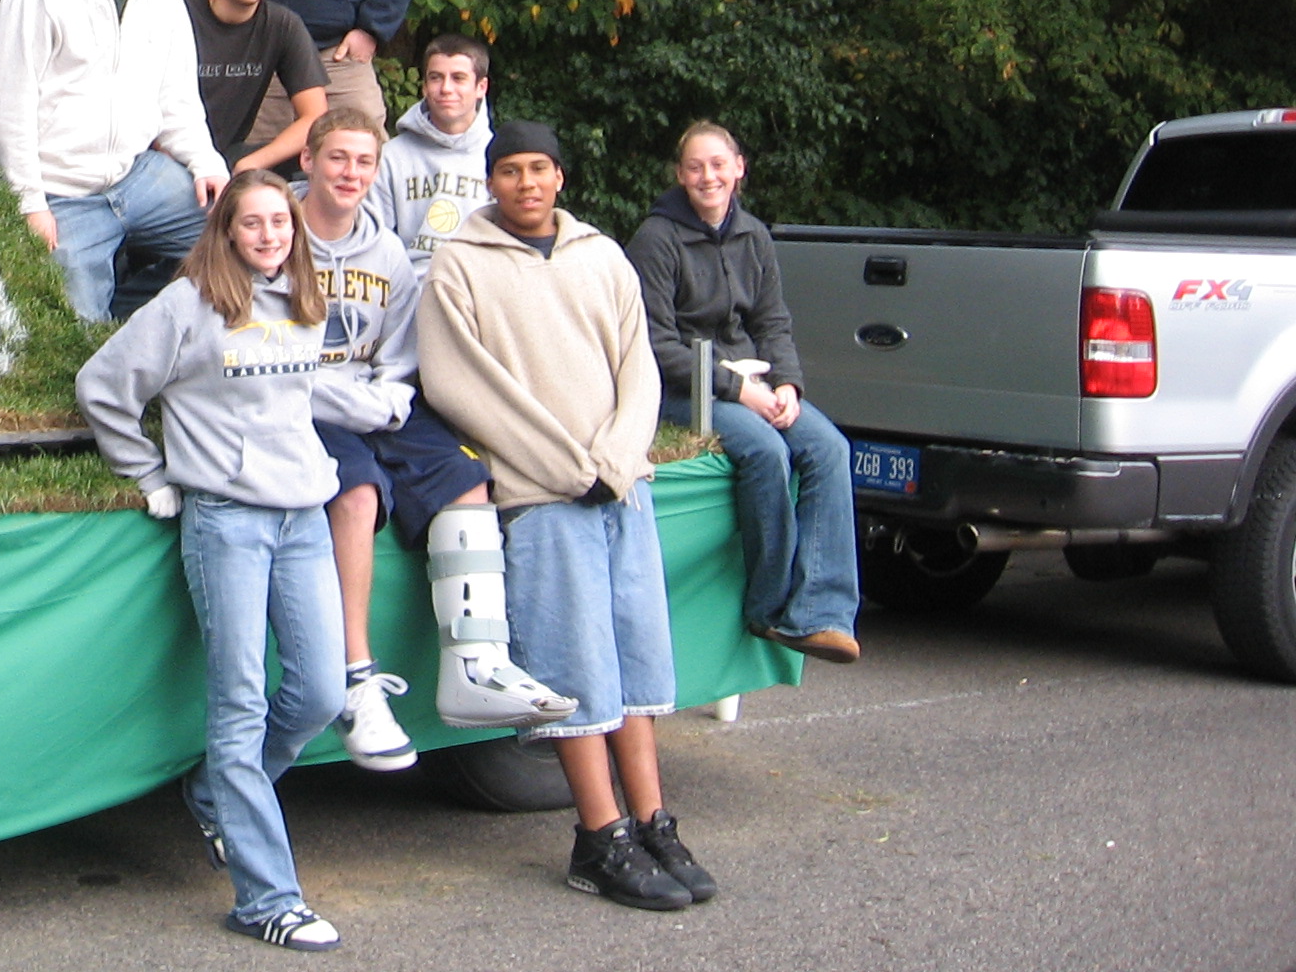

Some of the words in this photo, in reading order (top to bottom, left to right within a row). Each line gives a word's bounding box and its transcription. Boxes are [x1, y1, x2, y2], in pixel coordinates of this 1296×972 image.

[405, 172, 497, 202] HASLET
[1172, 279, 1253, 301] FX4
[223, 343, 321, 368] HASLET
[225, 363, 318, 377] BASKETBA
[855, 451, 880, 477] ZGB
[889, 455, 914, 481] 393
